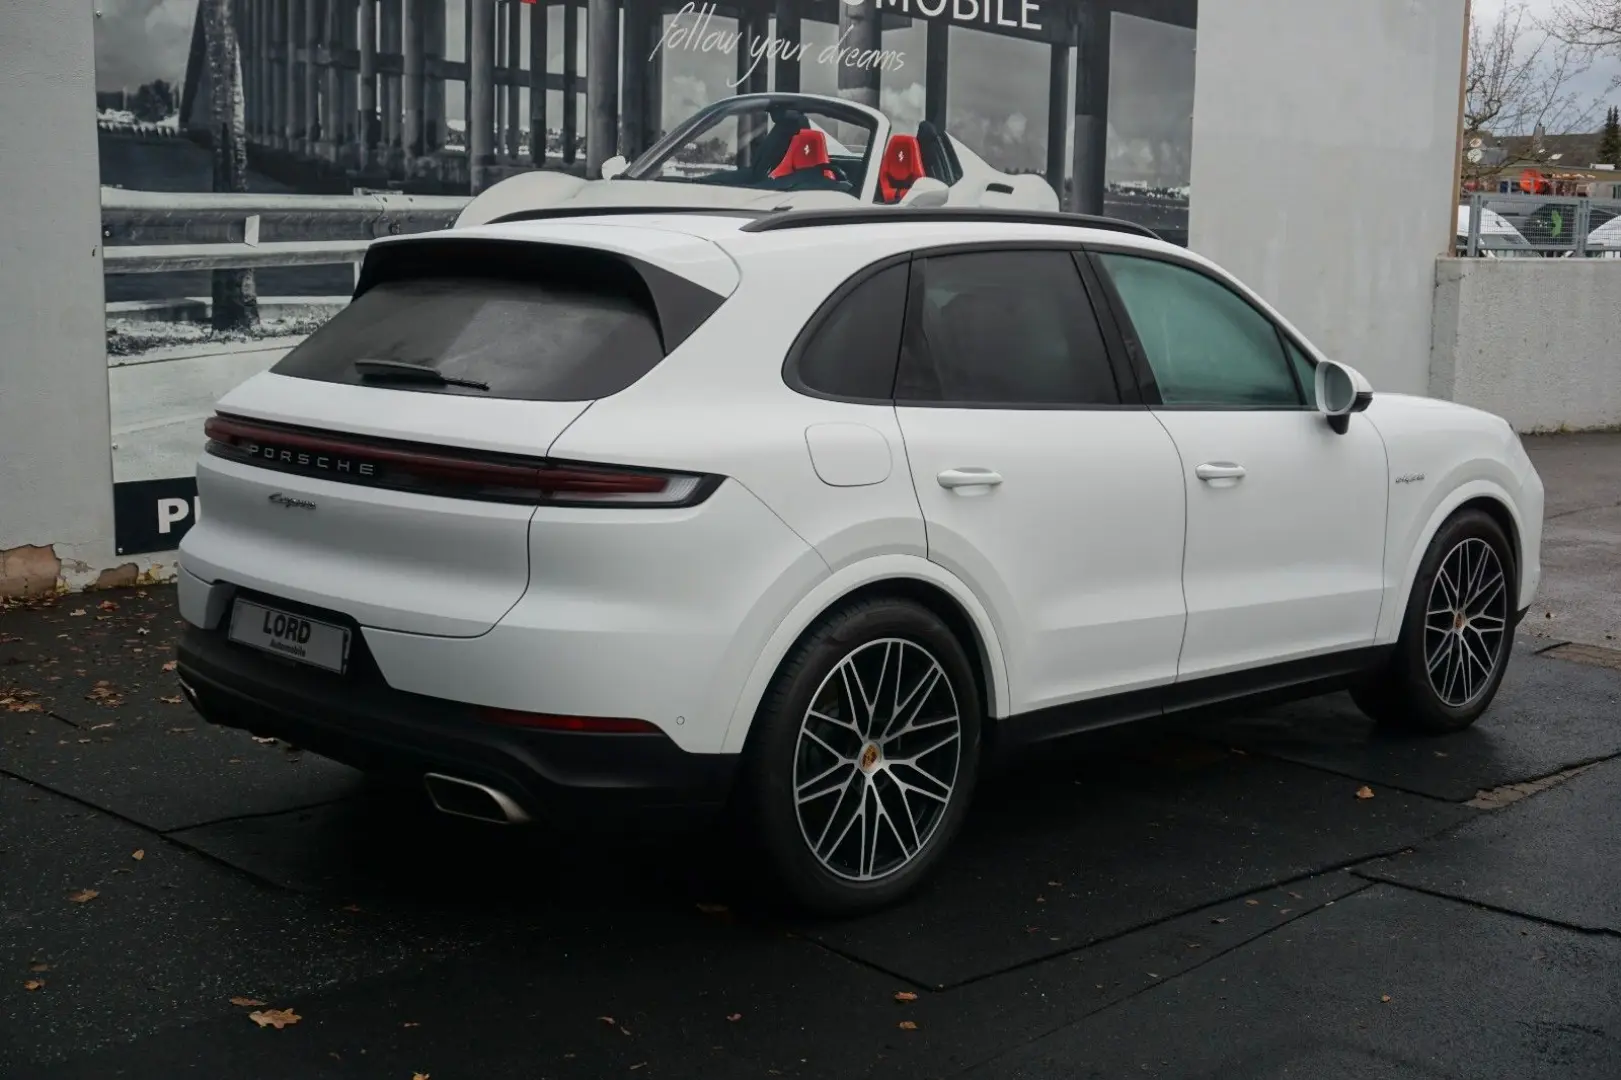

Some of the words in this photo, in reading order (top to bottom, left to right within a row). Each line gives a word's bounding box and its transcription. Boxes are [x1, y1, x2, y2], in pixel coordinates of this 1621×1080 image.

[648, 1, 743, 62] follow
[726, 35, 813, 88] your
[818, 24, 906, 71] dreams
[248, 444, 375, 476] PORSCHE
[157, 496, 202, 534] P
[262, 610, 312, 644] LORD
